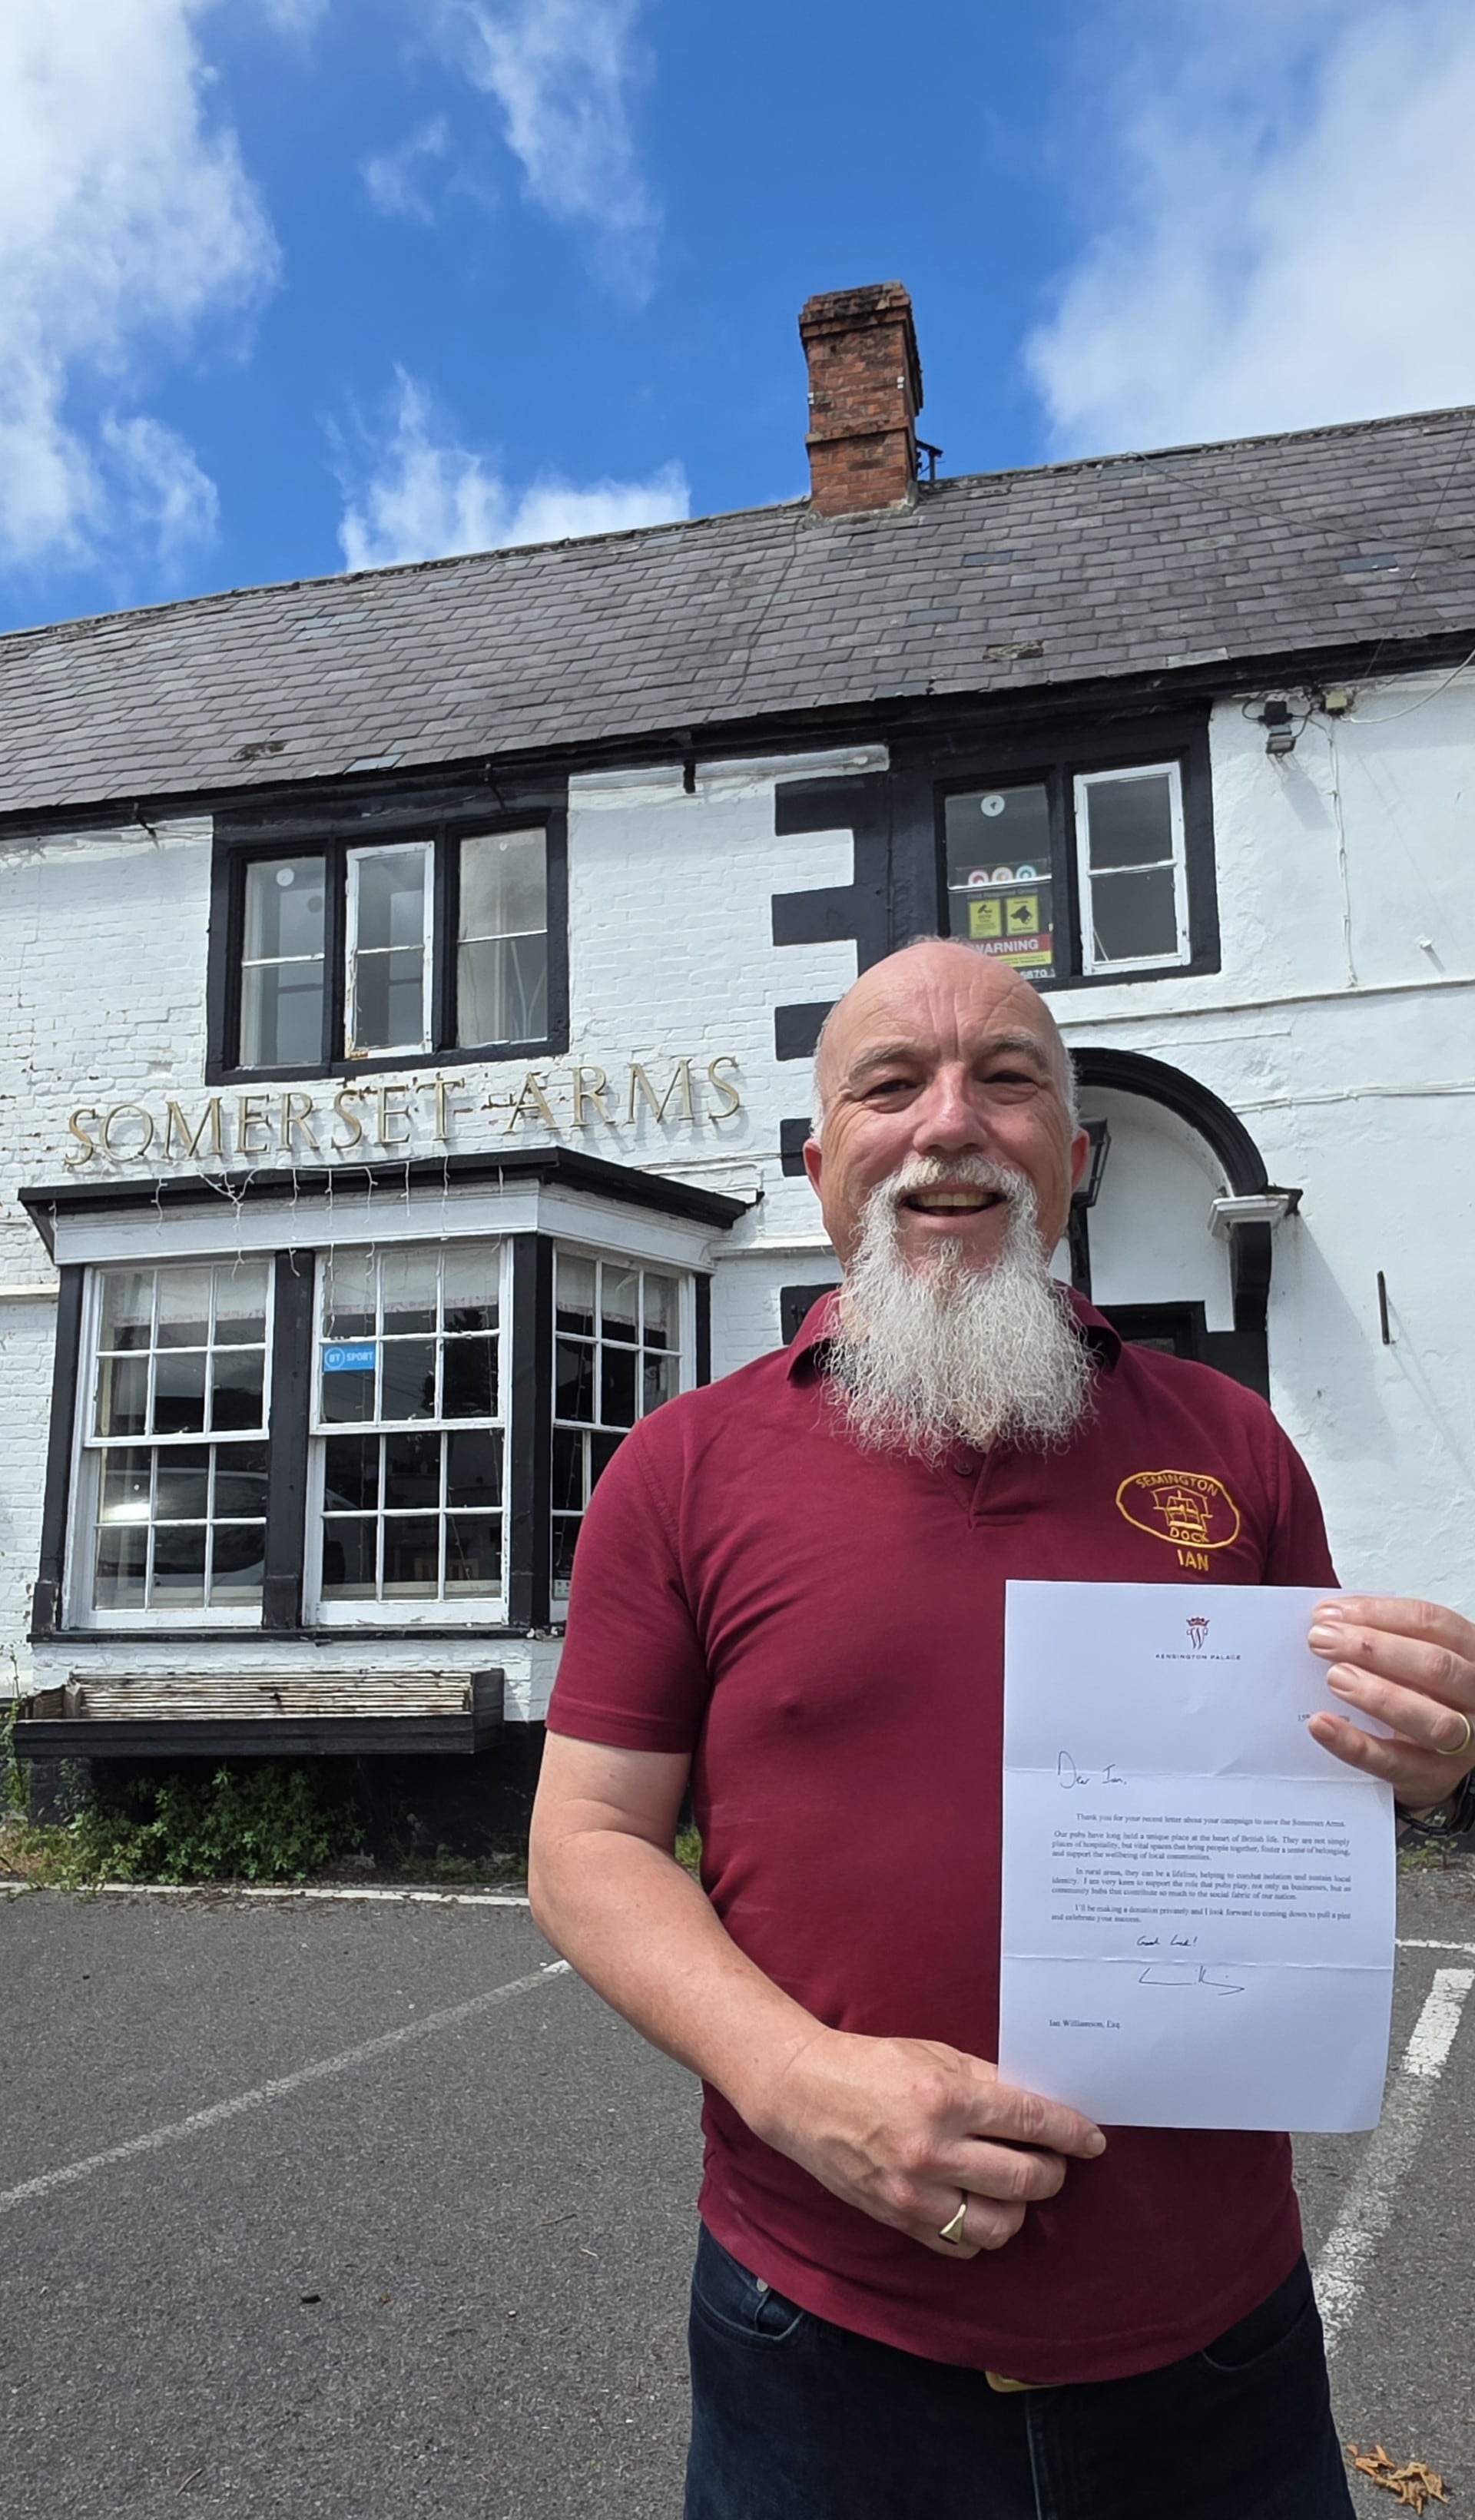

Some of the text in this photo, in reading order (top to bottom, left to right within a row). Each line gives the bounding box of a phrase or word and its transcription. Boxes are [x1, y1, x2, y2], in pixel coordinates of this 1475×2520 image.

[64, 1055, 741, 1169] SOMERSET ARMS
[328, 1351, 373, 1363] BT SPORT
[1135, 1474, 1219, 1497] SEMINGTON
[1169, 1527, 1210, 1544] DOCK
[1177, 1549, 1209, 1572] IAN
